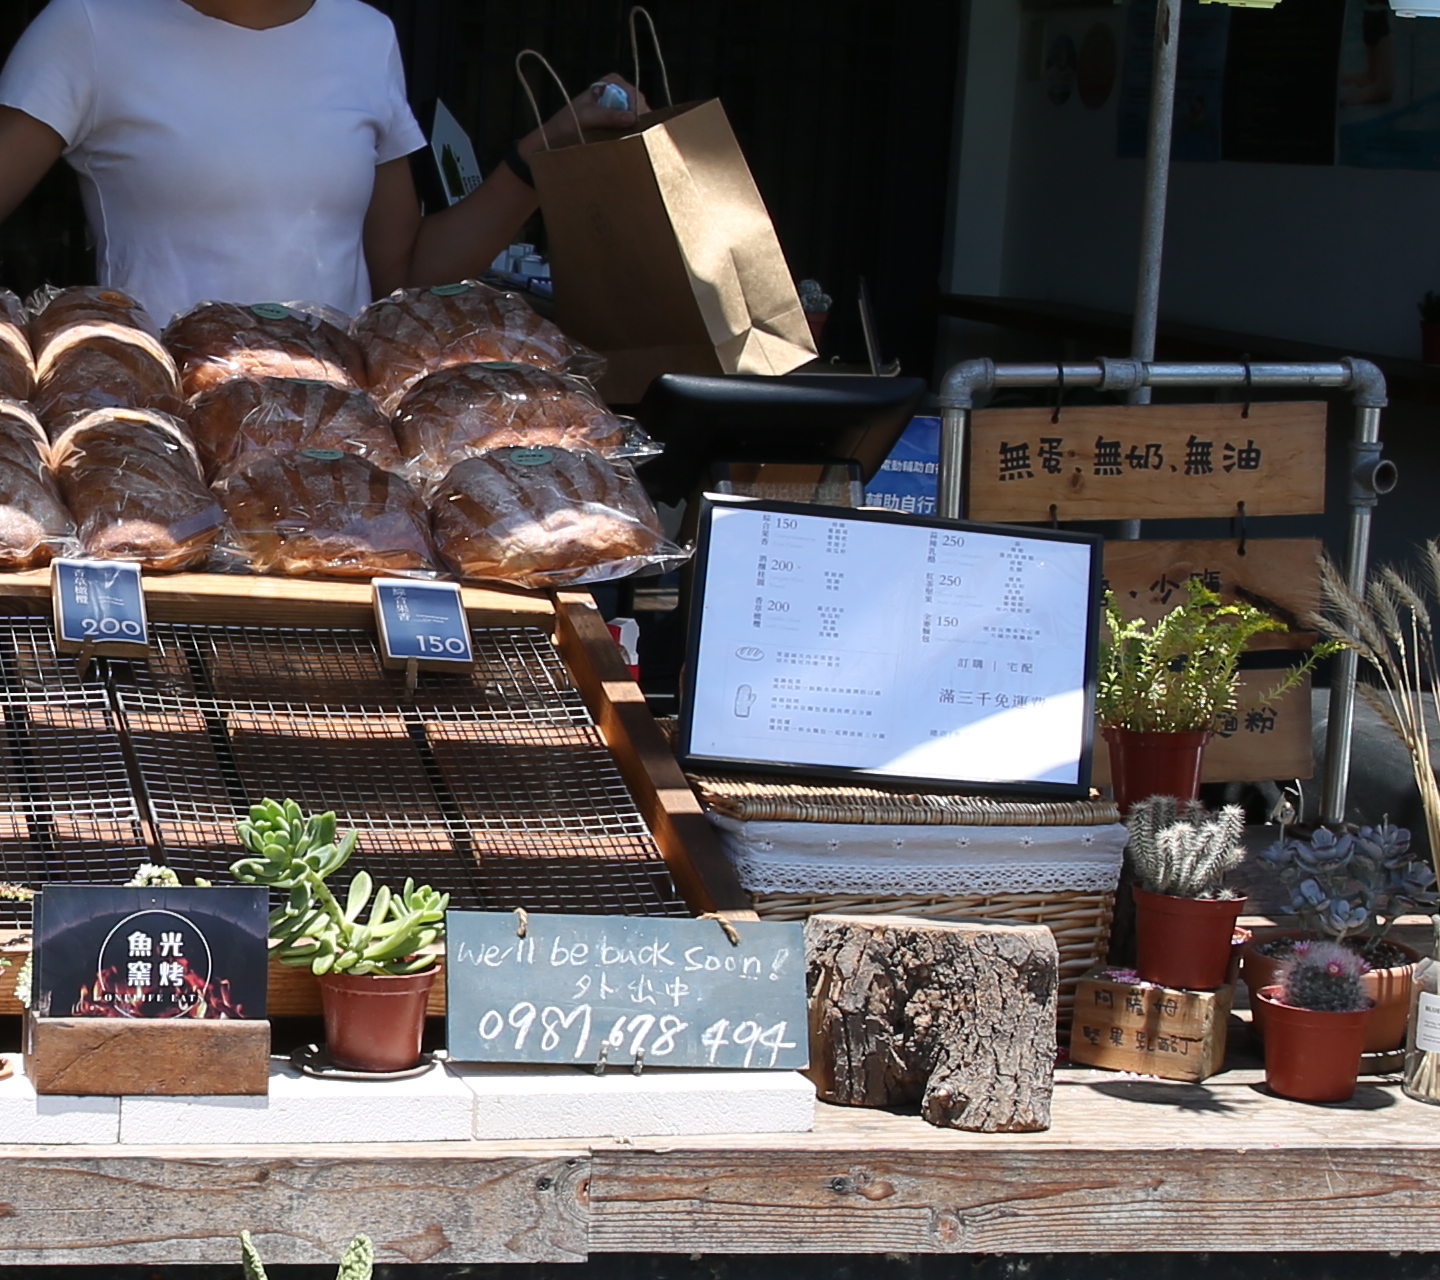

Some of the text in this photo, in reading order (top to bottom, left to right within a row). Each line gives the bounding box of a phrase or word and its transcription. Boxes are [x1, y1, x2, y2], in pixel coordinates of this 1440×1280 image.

[865, 492, 937, 514] 輔助自行
[775, 518, 798, 530] 150
[942, 535, 964, 548] 250
[771, 559, 794, 572] 200
[939, 575, 962, 587] 250
[767, 600, 790, 613] 200
[81, 617, 141, 636] 200
[937, 616, 959, 628] 150
[416, 635, 465, 654] 150
[127, 931, 184, 957] 魚光
[550, 936, 589, 967] be
[127, 961, 184, 987] 窯烤
[573, 971, 690, 1007] 外出中
